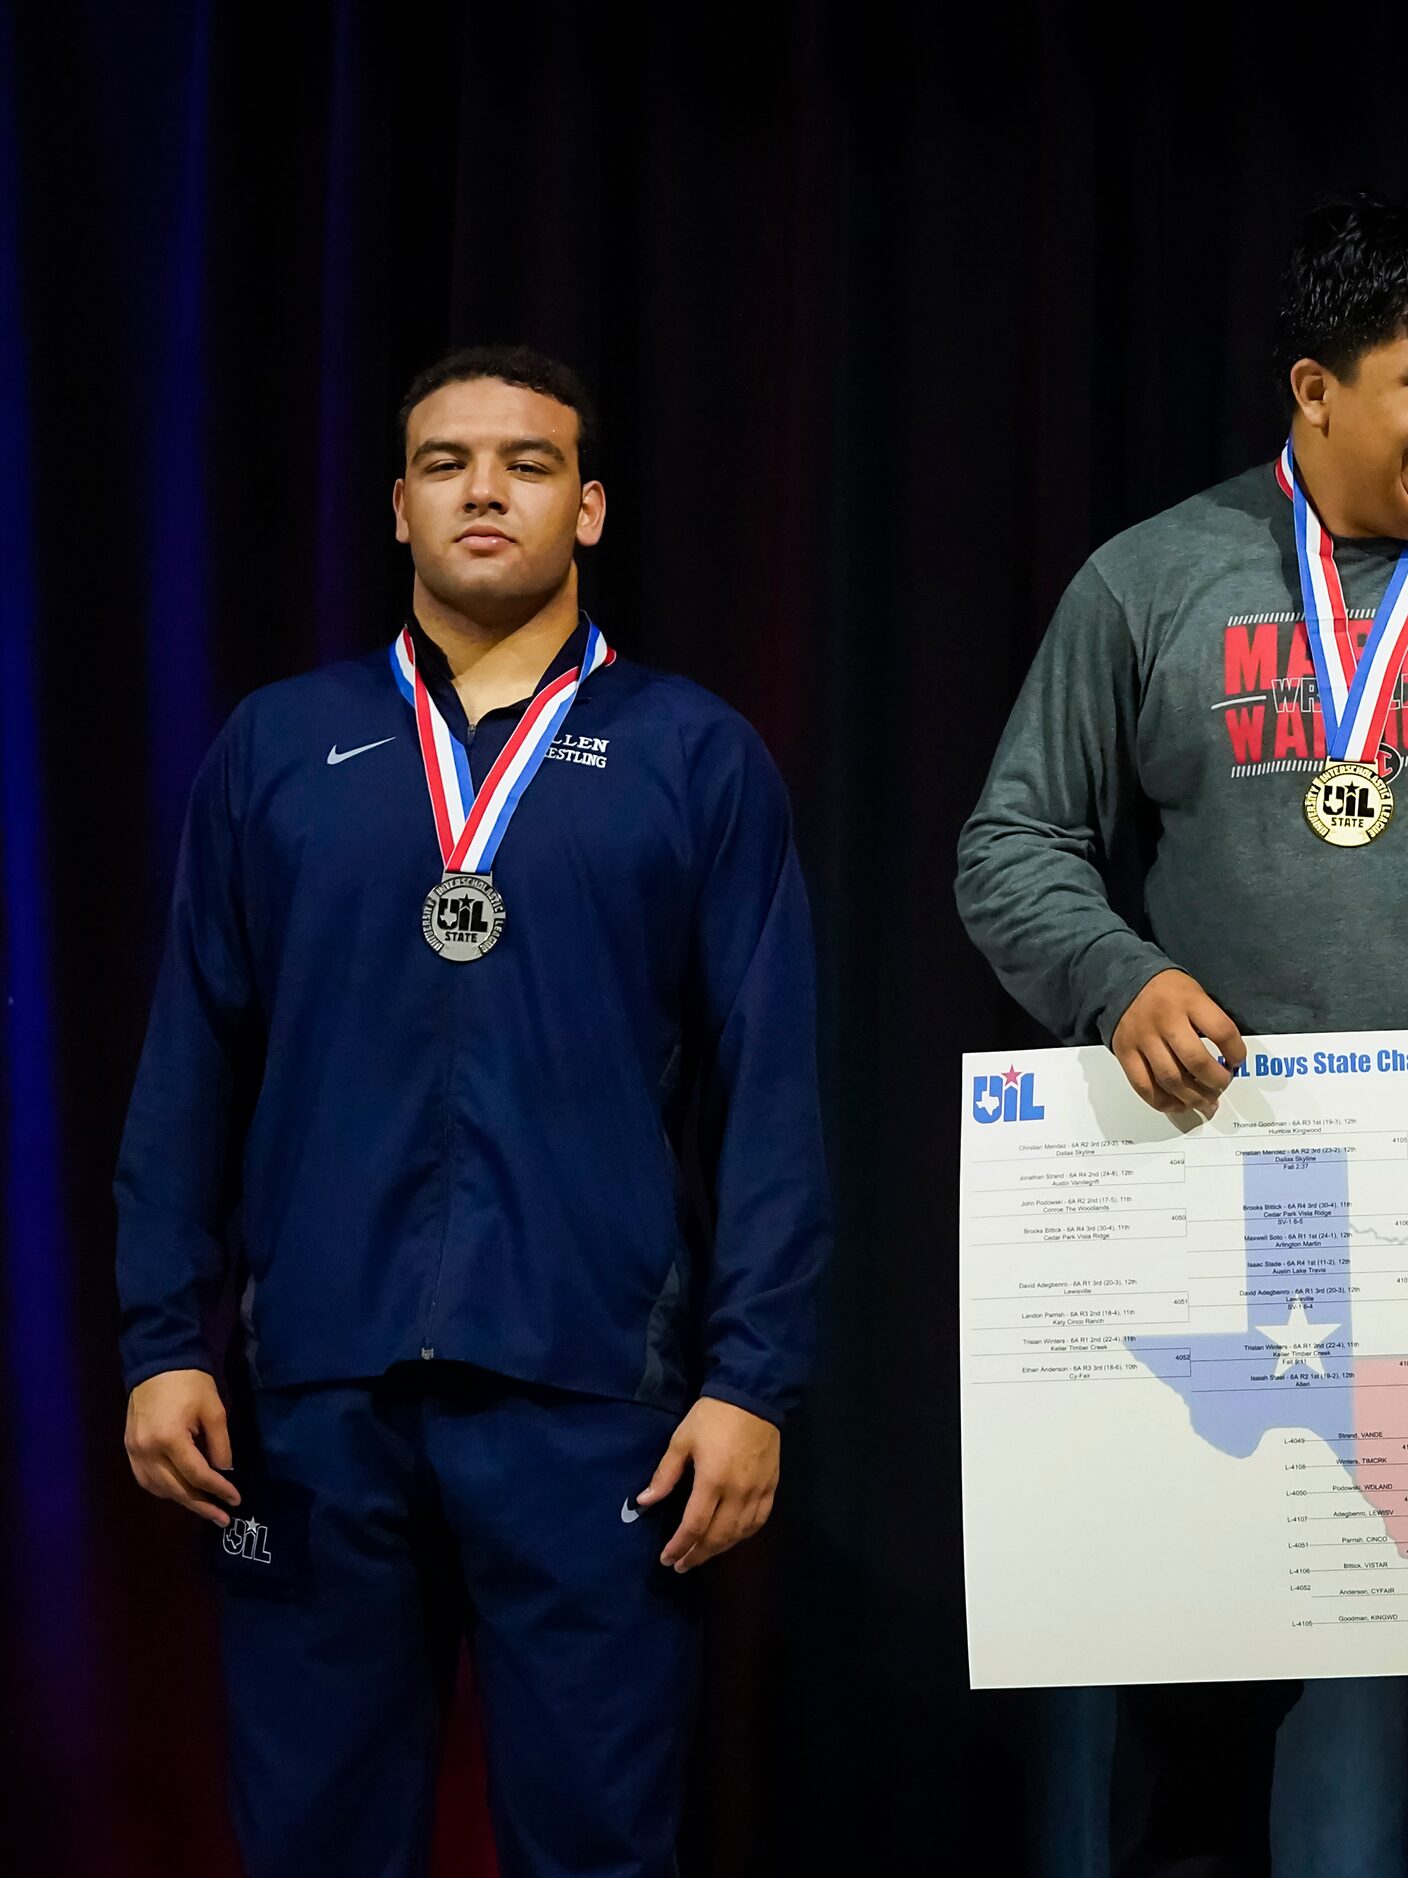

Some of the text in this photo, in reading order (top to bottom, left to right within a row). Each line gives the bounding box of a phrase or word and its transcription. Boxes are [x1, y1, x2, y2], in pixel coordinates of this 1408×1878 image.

[552, 734, 609, 753] LEN
[545, 747, 607, 768] ESTLING
[1319, 765, 1391, 800] INTERSCHOLASTIC
[1305, 784, 1329, 837] UNIVERSITY
[1331, 817, 1364, 828] STATE
[1366, 804, 1392, 838] LEAGUE
[444, 932, 478, 943] STATE
[1255, 1053, 1308, 1078] Boys
[1314, 1051, 1371, 1074] State
